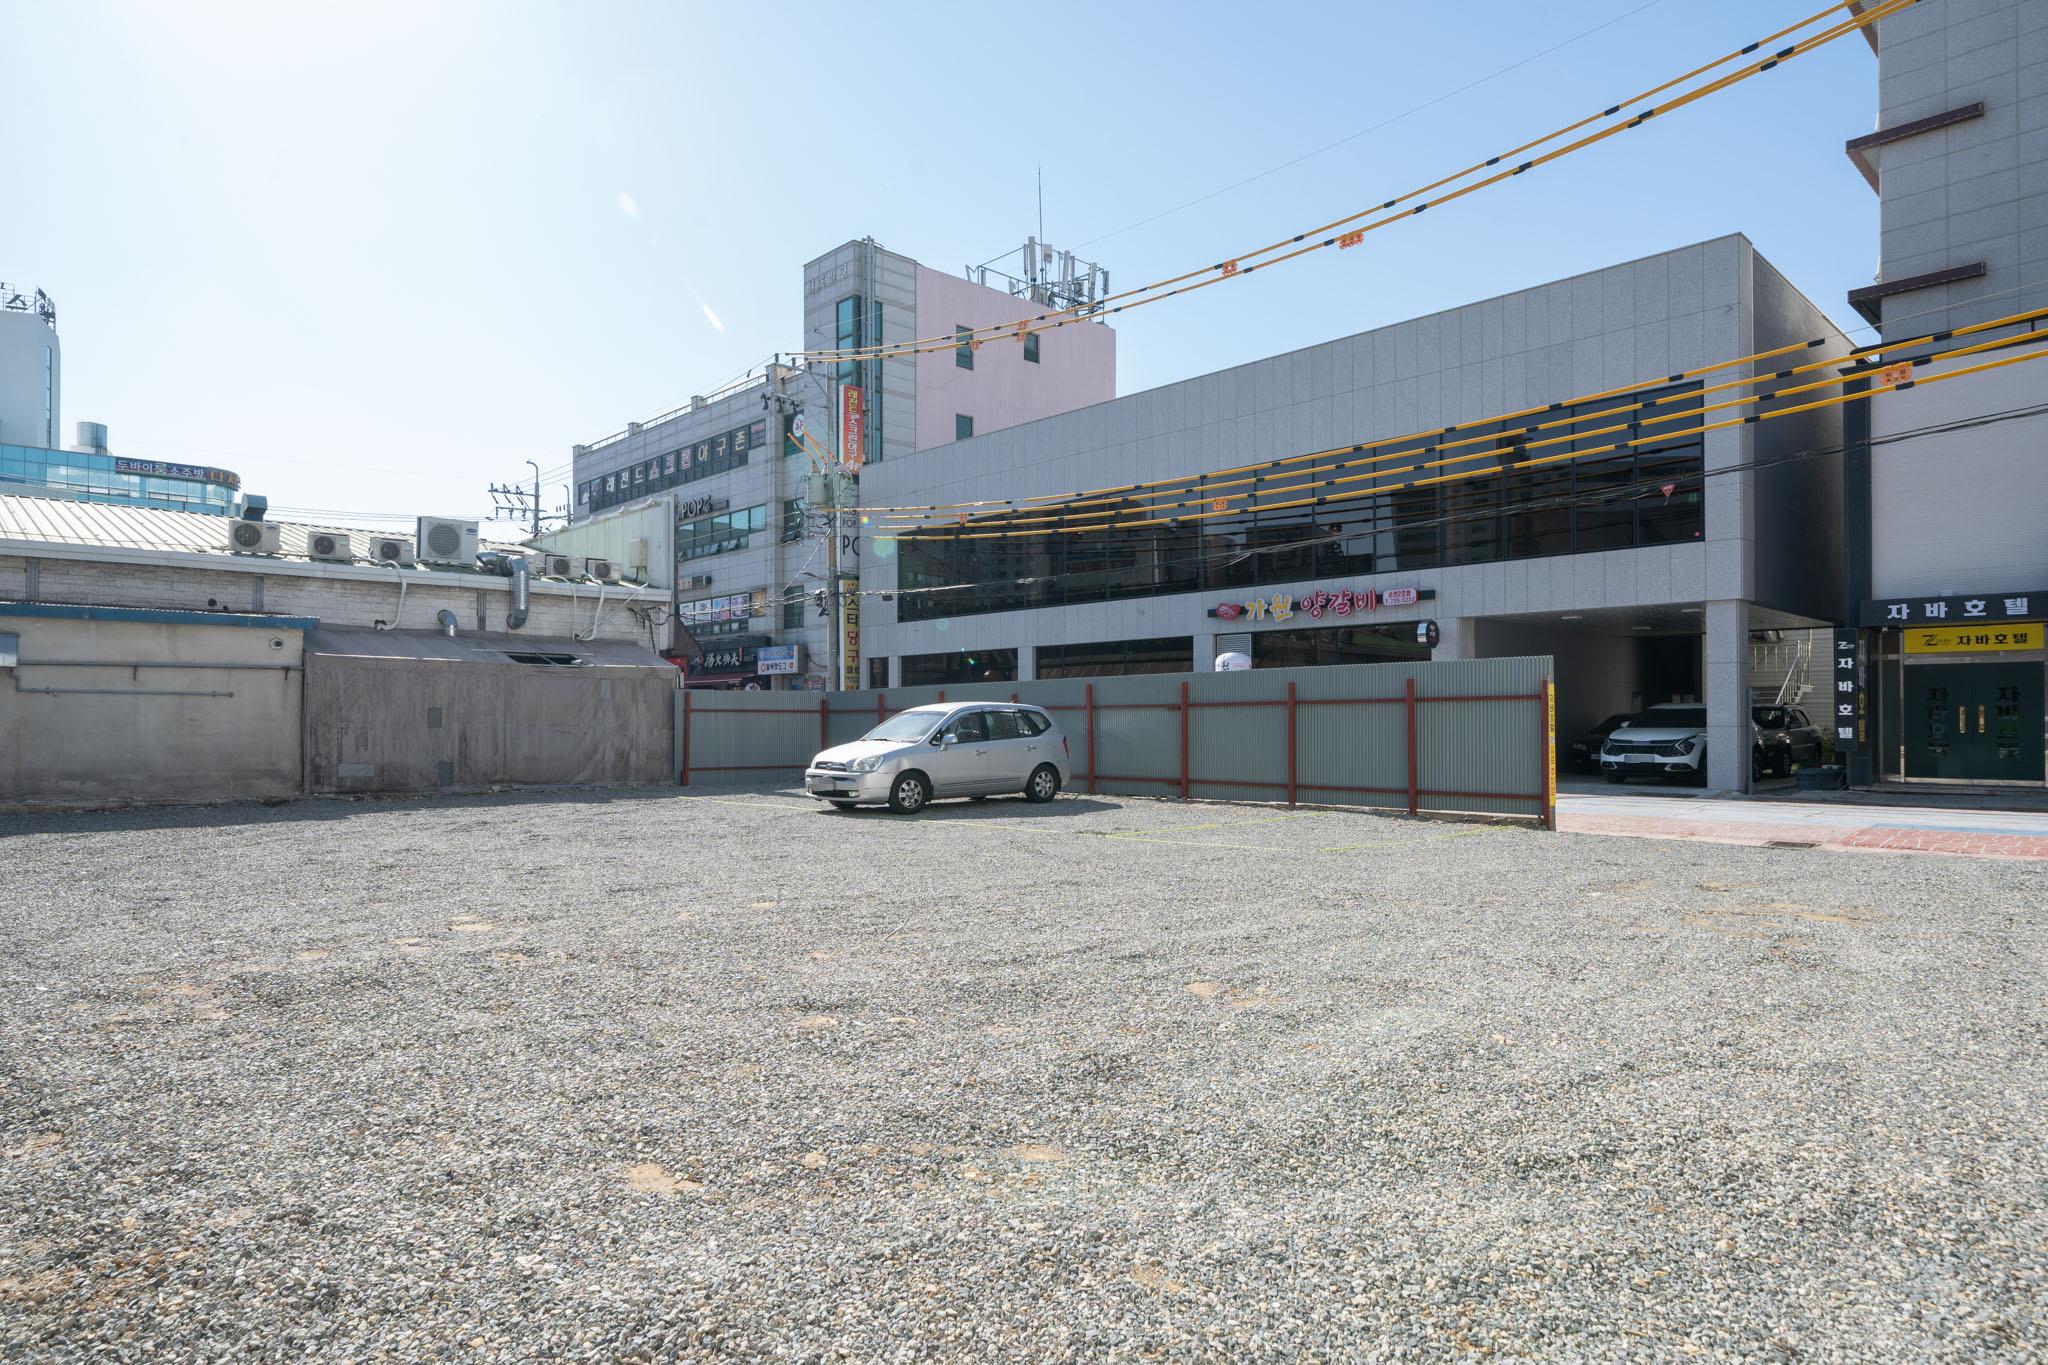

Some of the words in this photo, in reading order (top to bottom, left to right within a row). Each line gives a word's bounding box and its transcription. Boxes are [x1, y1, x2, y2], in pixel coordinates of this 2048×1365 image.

[1245, 593, 1294, 622] 가원
[1300, 587, 1377, 620] 양갈비
[1887, 598, 2029, 620] 자바호텔
[1957, 632, 2028, 646] 자바호텔
[1838, 657, 1854, 739] 자바호텔
